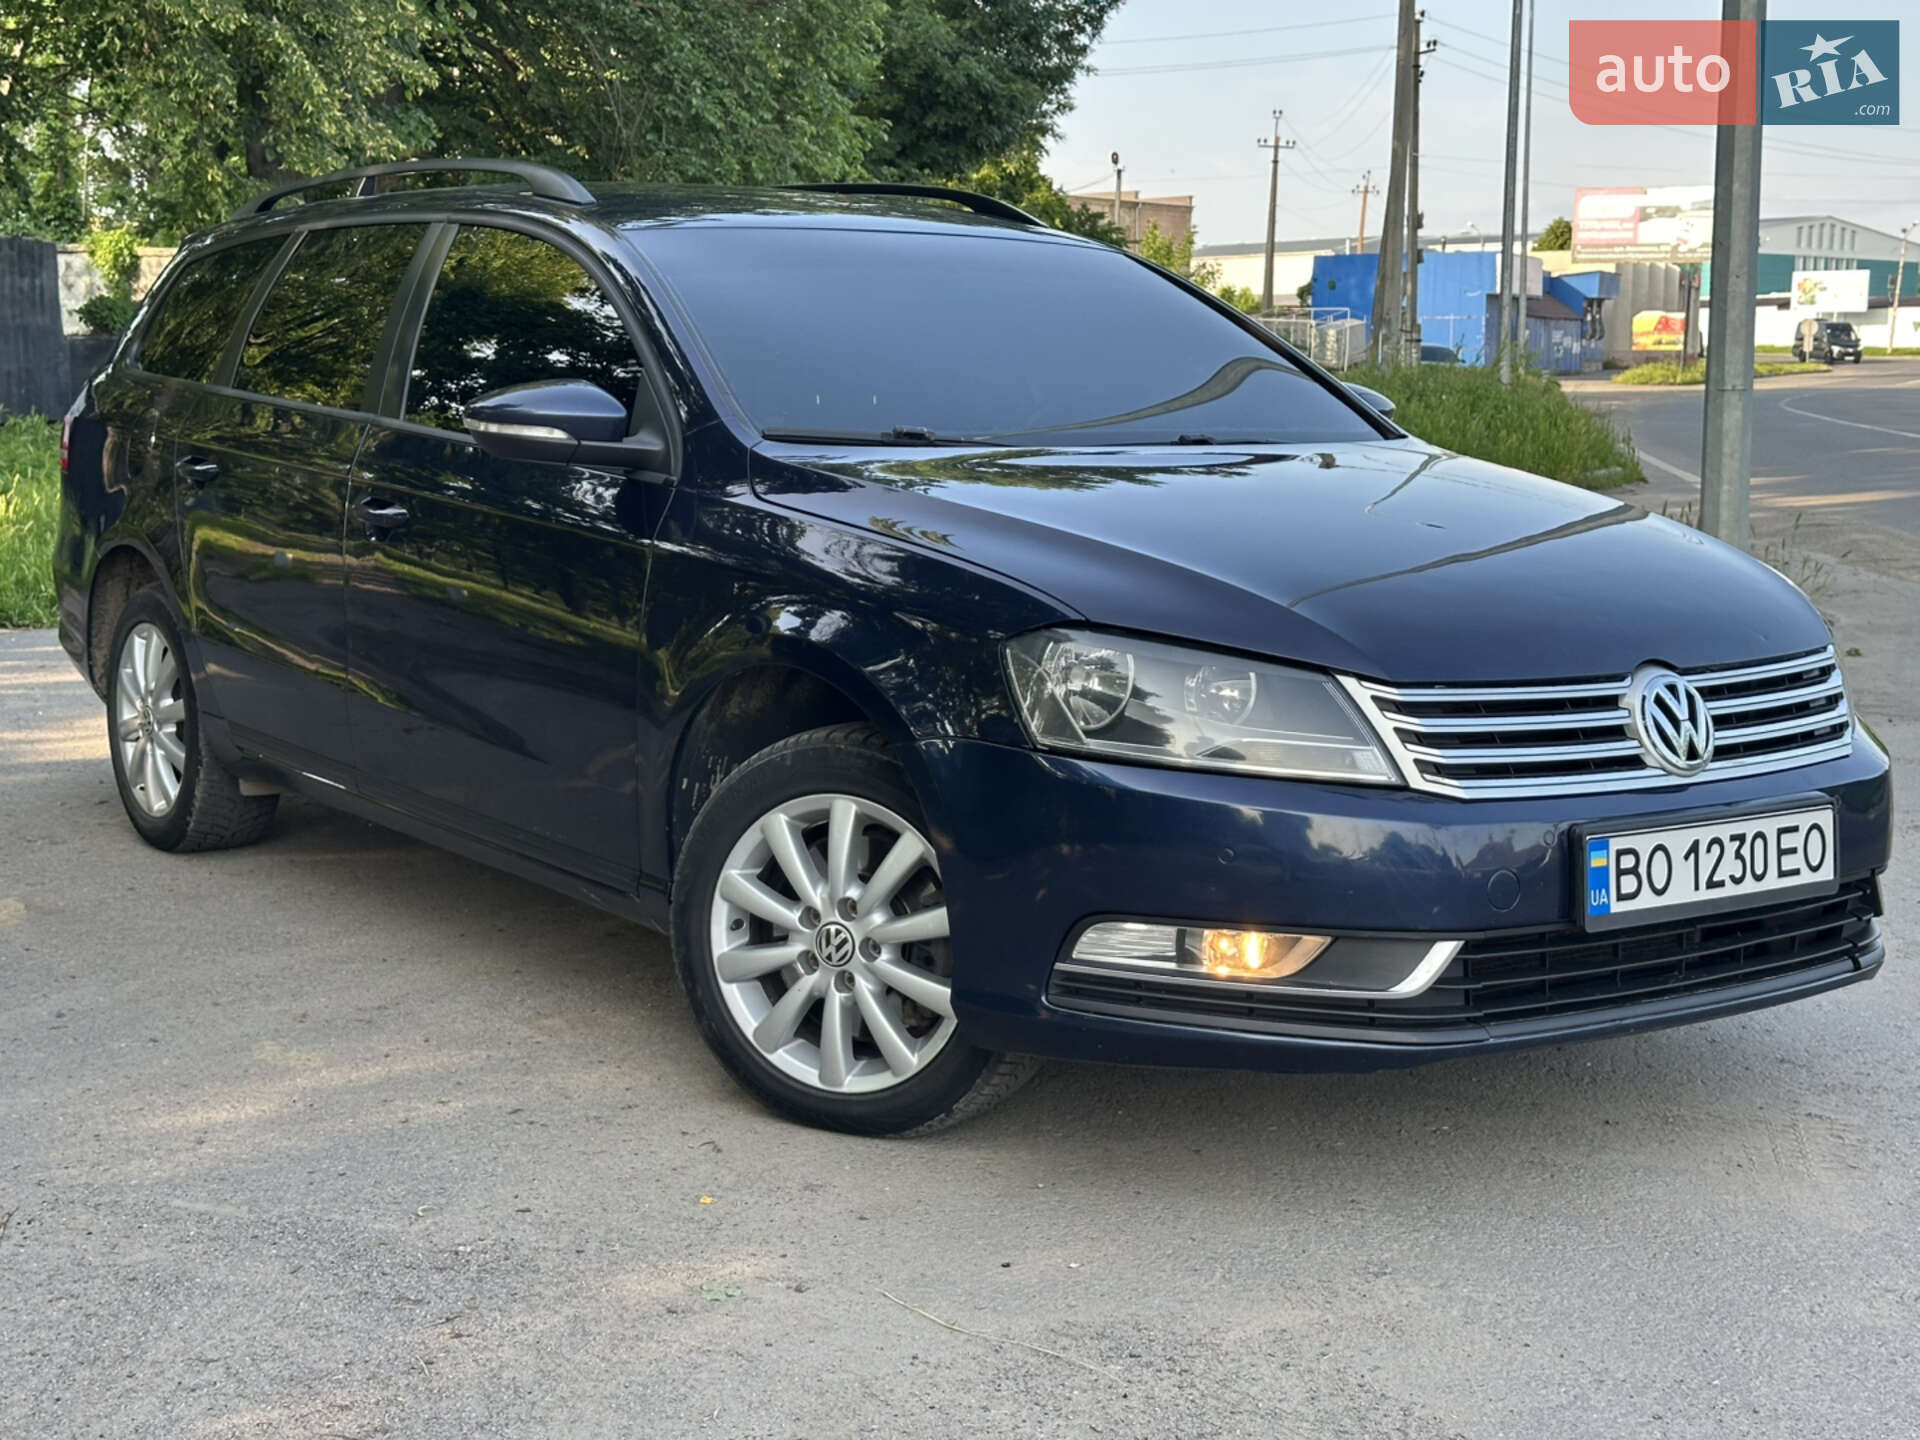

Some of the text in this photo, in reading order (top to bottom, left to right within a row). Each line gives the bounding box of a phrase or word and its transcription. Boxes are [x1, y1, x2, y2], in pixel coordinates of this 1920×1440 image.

[1615, 822, 1827, 902] BO 1230 EO
[1591, 889, 1608, 906] UA
